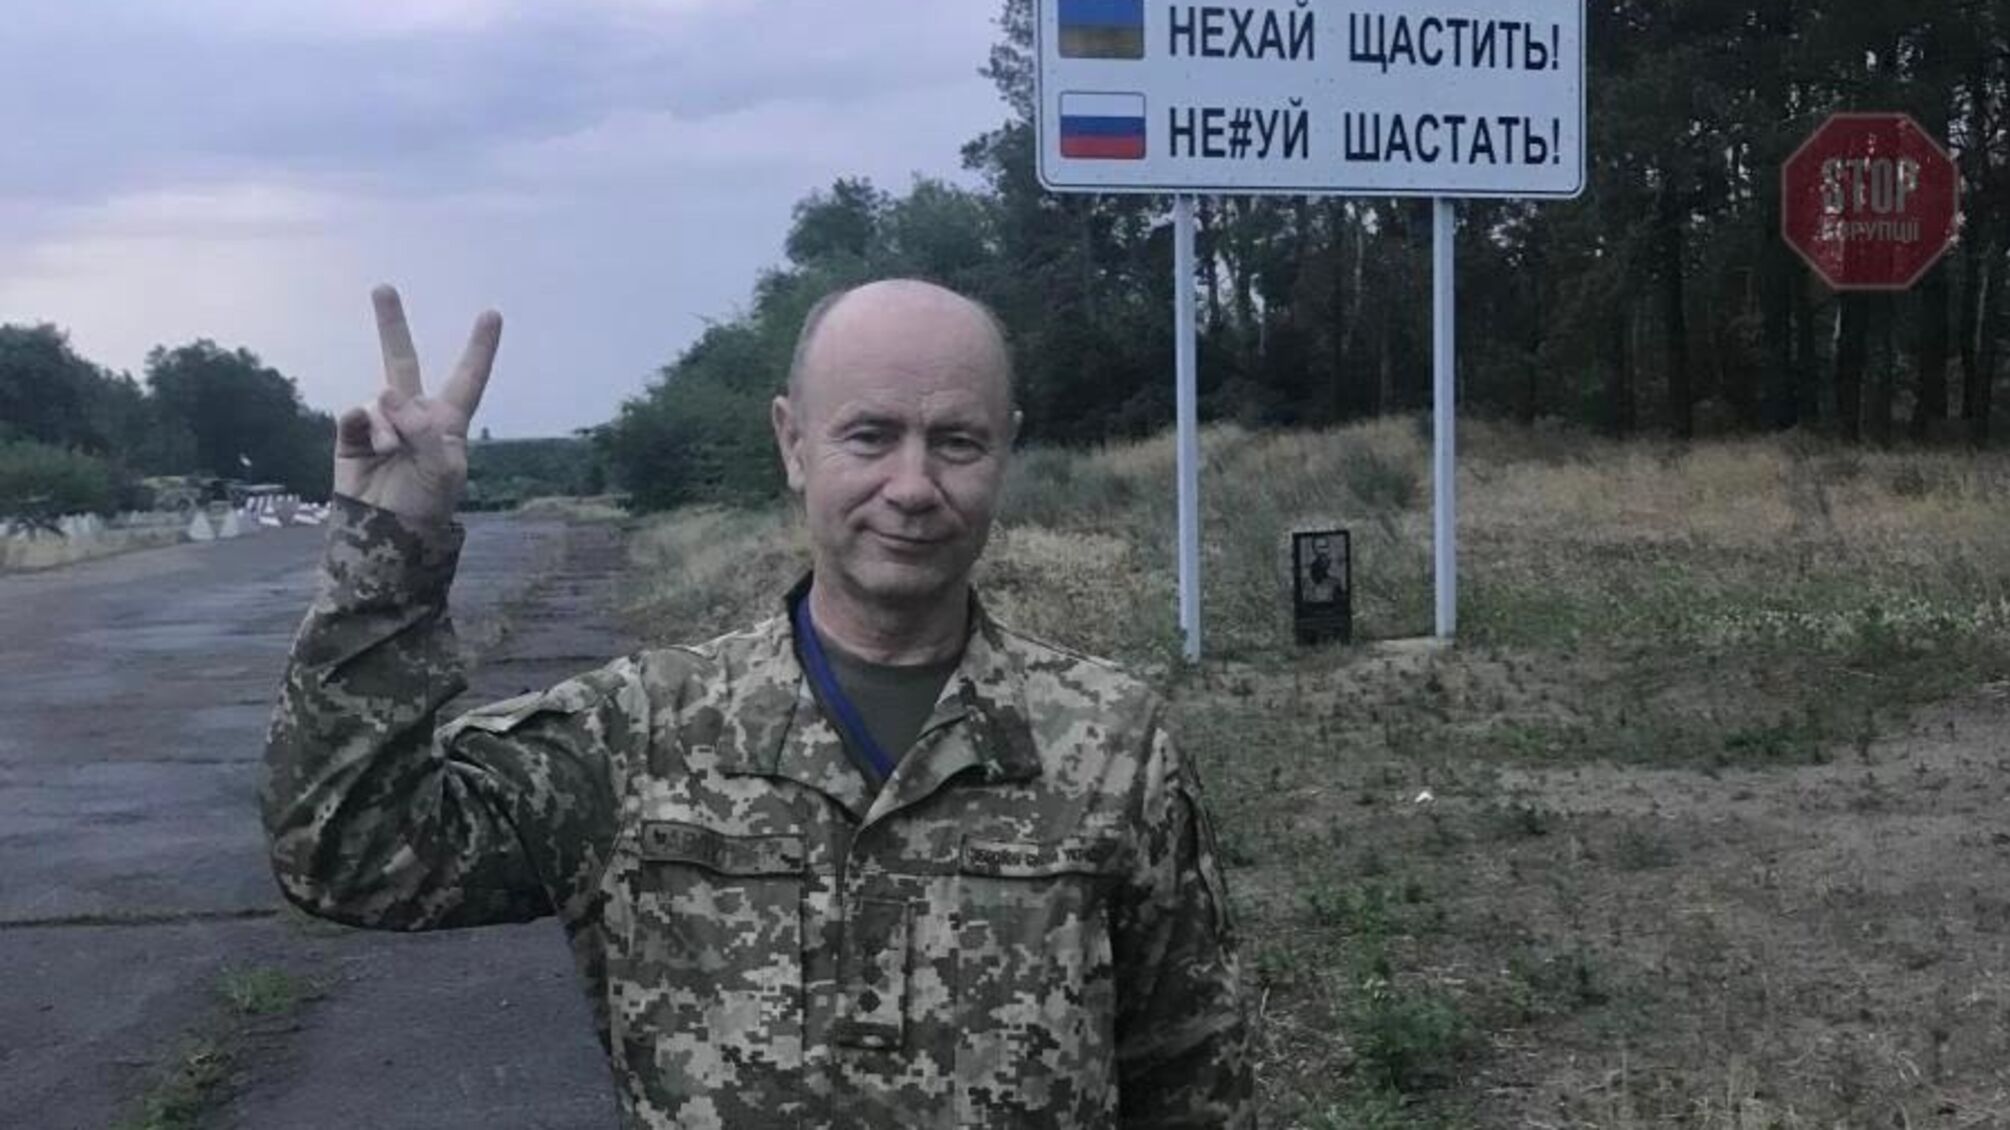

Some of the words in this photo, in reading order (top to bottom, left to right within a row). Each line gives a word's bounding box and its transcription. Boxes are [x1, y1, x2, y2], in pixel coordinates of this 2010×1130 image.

[1169, 0, 1315, 61] НЕХАЙ
[1348, 13, 1559, 73] ЩАСТИТЬ!
[1169, 98, 1309, 158] НЕ#УЙ
[1344, 112, 1560, 165] ШАСТАТЬ!
